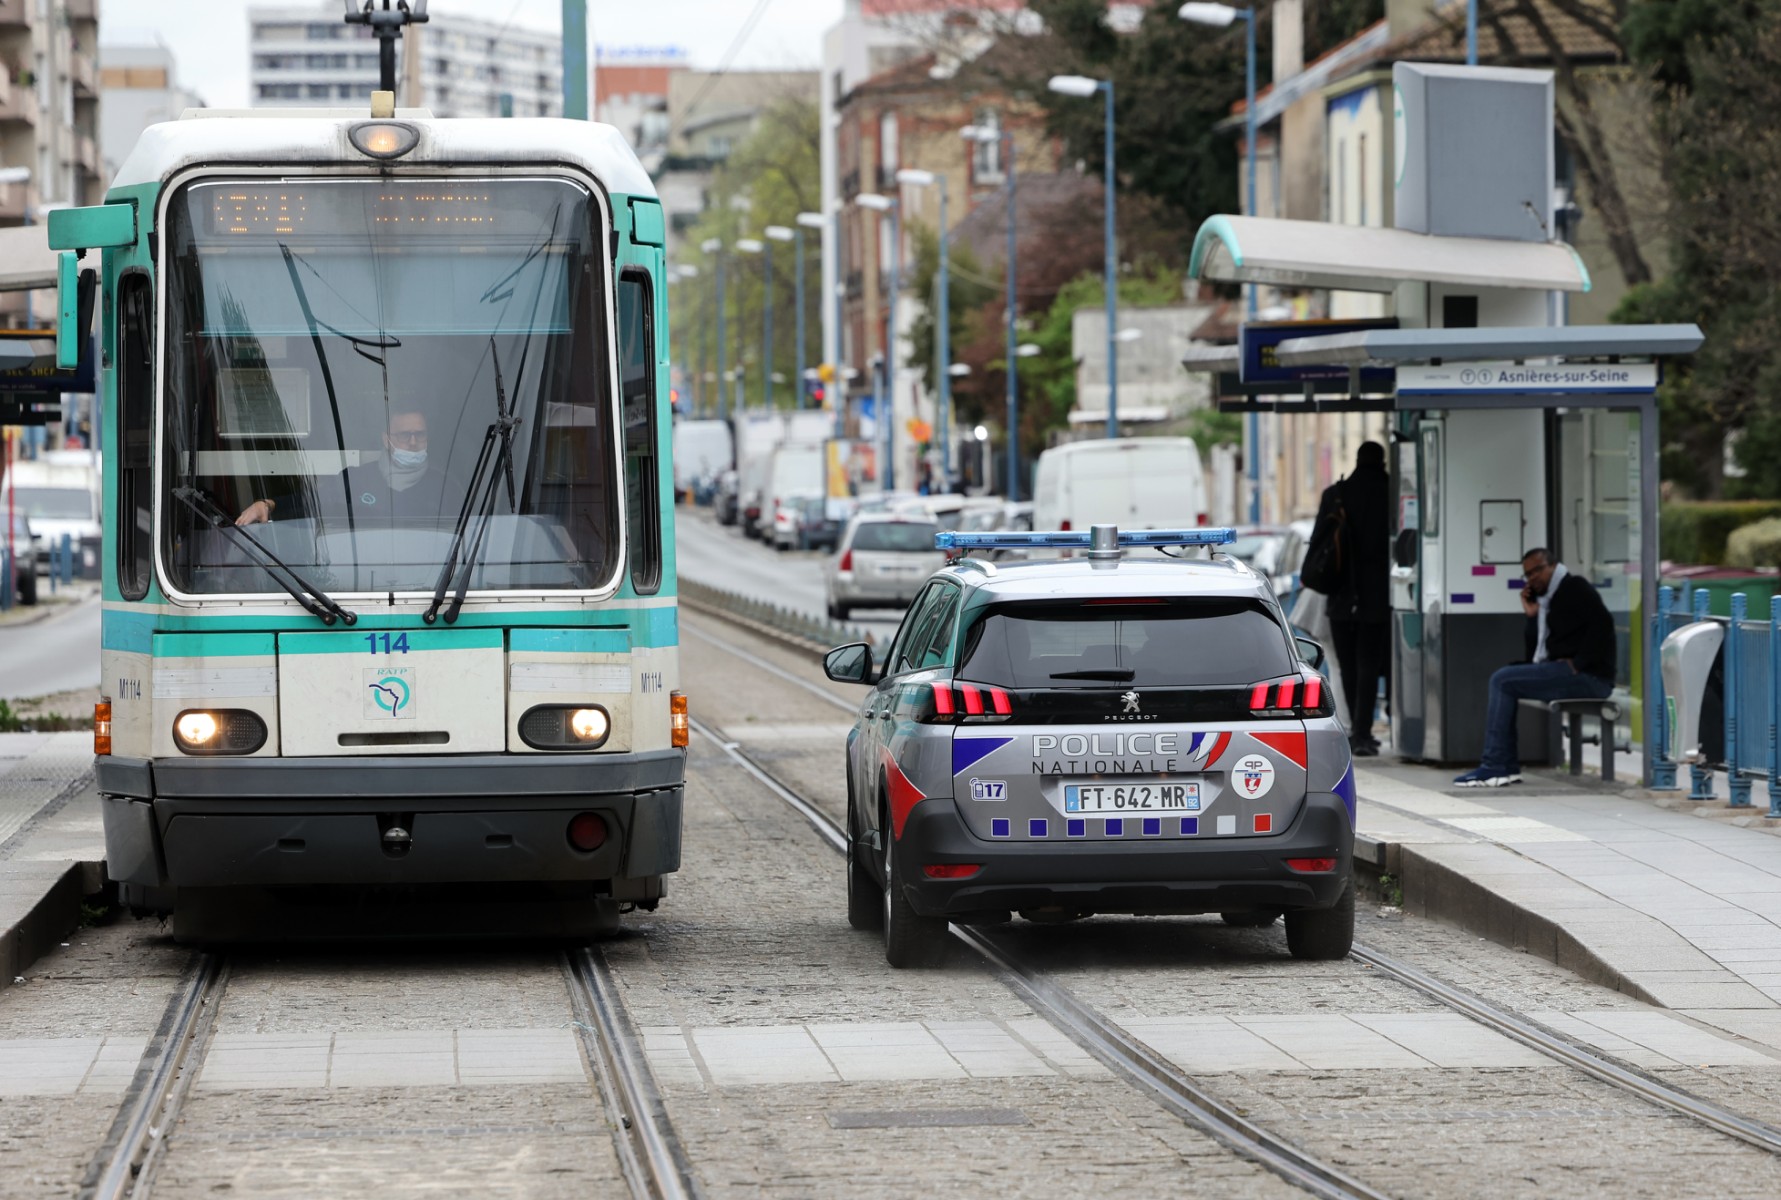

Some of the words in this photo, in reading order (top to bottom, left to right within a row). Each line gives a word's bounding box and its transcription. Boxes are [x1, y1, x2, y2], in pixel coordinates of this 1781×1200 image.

[1499, 369, 1629, 384] Asnières-sur-Seine
[364, 632, 410, 655] 114
[377, 668, 408, 676] RATP
[1032, 733, 1179, 757] POLICE
[1032, 759, 1177, 774] NATIONALE
[985, 784, 1004, 798] 17
